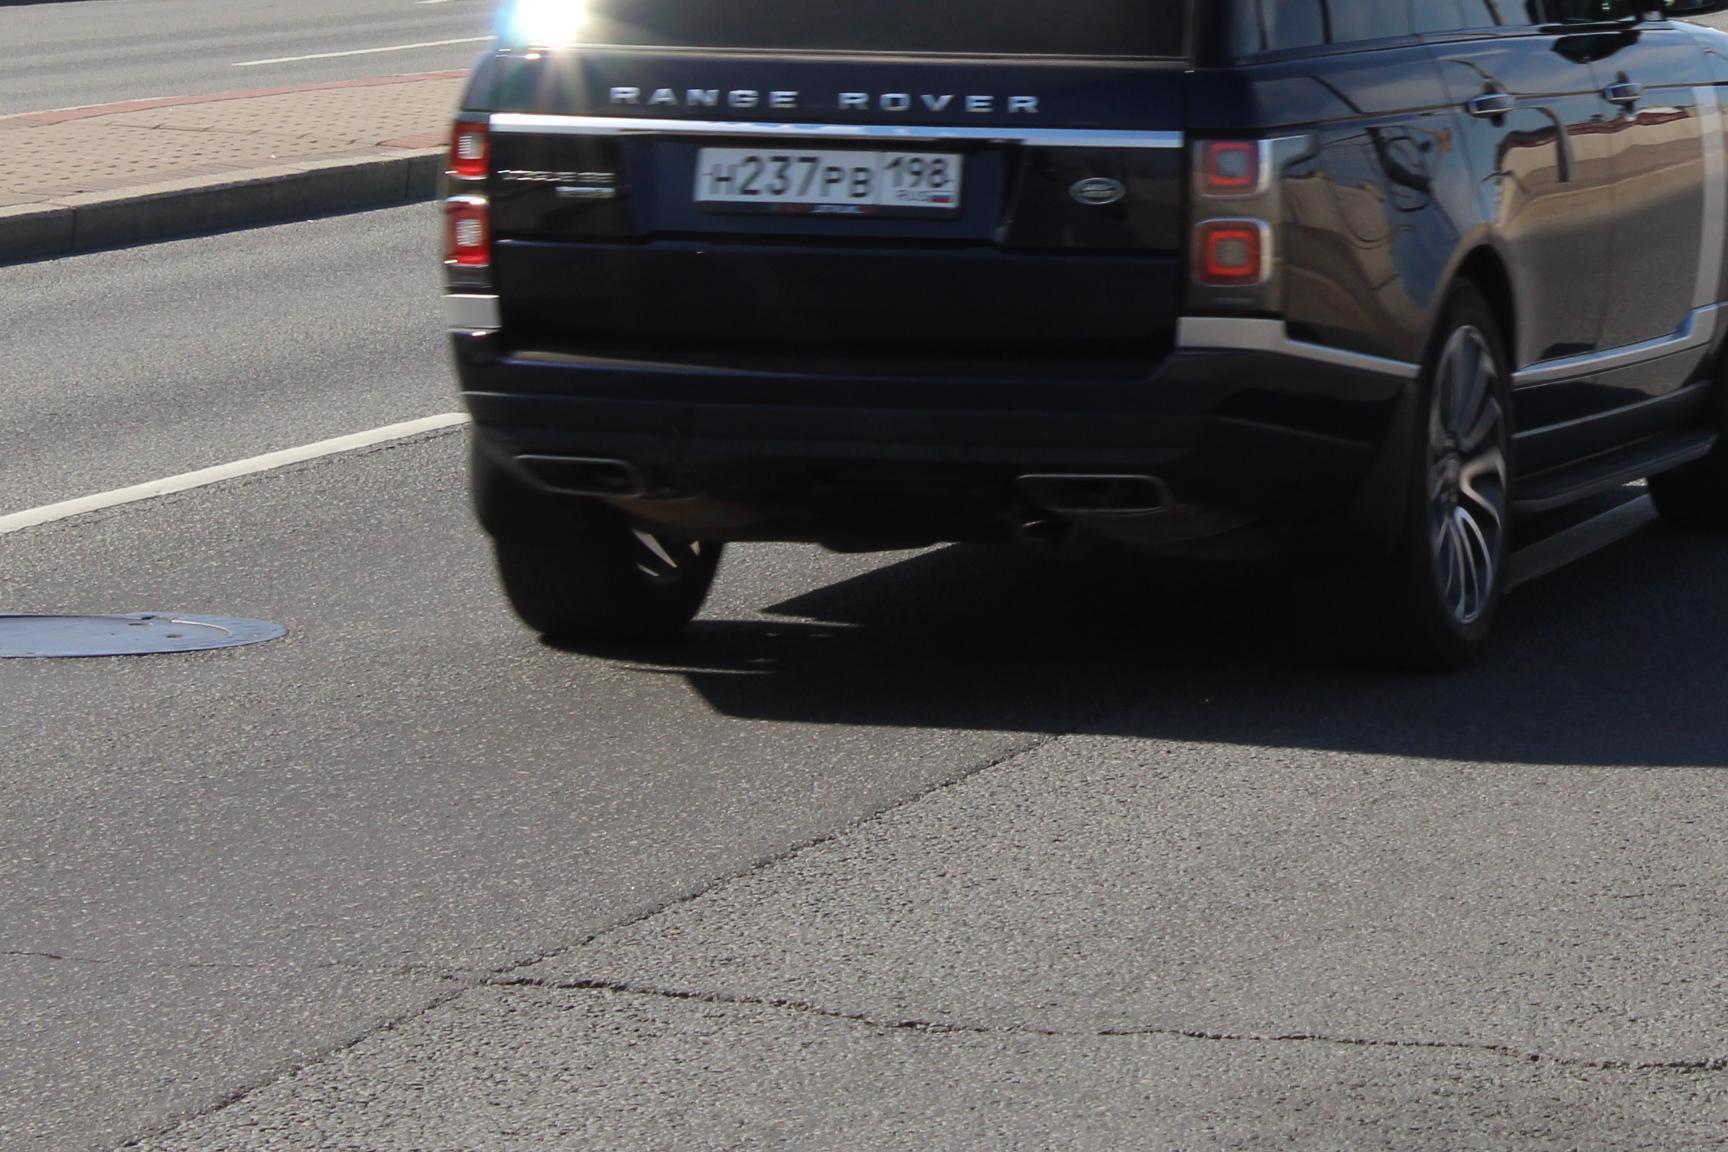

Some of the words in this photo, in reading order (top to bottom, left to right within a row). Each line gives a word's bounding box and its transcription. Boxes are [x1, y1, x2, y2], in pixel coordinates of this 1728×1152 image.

[608, 85, 800, 109] RANGE
[837, 91, 1041, 114] ROVER
[884, 156, 948, 189] 198
